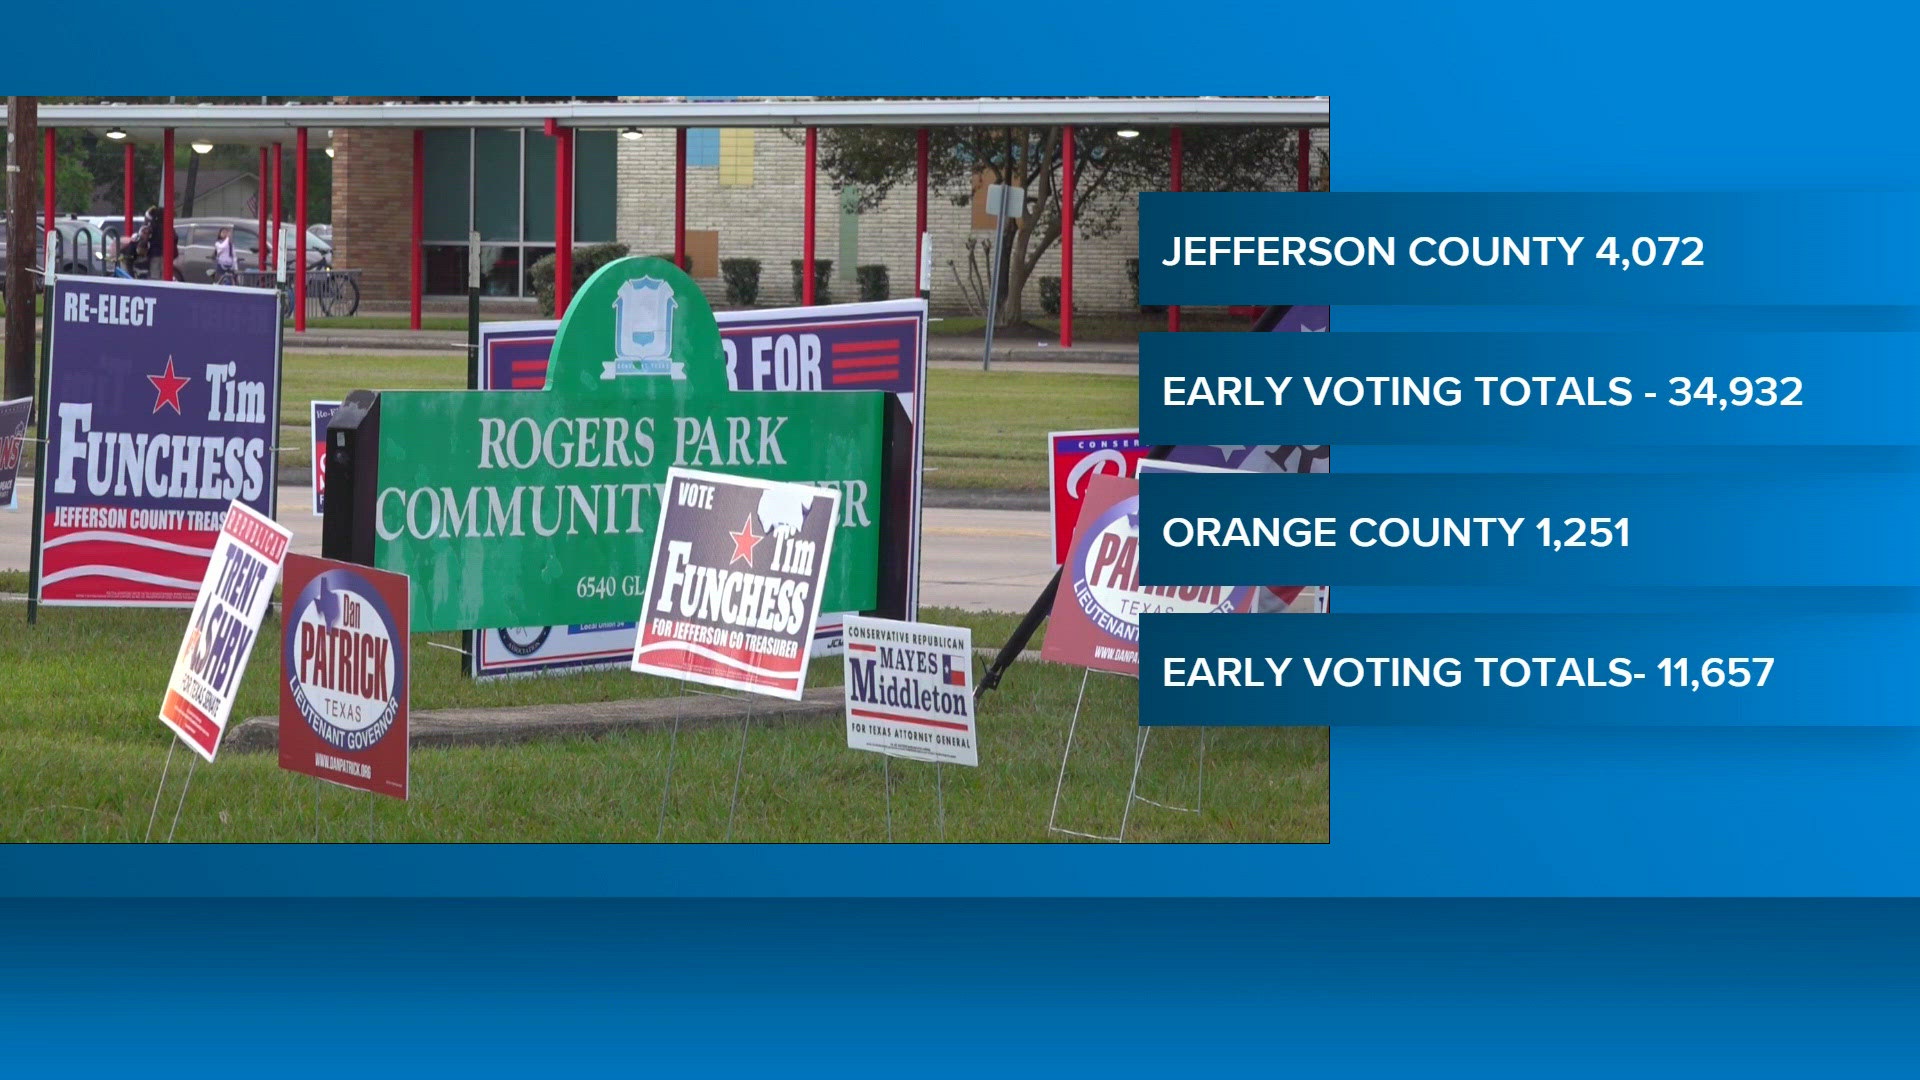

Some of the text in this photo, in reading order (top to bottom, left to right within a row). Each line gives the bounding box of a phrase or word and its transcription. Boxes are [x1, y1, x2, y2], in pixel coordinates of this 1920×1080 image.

[64, 292, 157, 326] RE-ELECT
[752, 333, 822, 391] FOR
[206, 361, 265, 424] Tim
[54, 403, 264, 500] FUNCHESS
[478, 416, 788, 470] ROGERS PARK
[1079, 439, 1139, 449] CONSER
[678, 482, 715, 510] VOTE
[54, 506, 228, 532] JEFFERSON COUNTY TREAS
[227, 509, 286, 560] REPUBLICAN
[770, 524, 815, 576] Tim
[215, 542, 267, 617] TRENT
[577, 575, 644, 598] 6540 GL
[656, 540, 809, 635] FUNCHESS
[343, 594, 360, 628] Dan
[651, 618, 799, 659] FOR JEFFERSON CO TREASURER
[848, 626, 964, 650] CONSERVATIVE REPUBLICAN
[301, 621, 388, 702] PATRICK
[880, 647, 938, 675] MAYES
[849, 657, 967, 716] Middleton
[290, 675, 398, 749] LIEUTENANT GOVERNOR
[325, 698, 361, 722] TEXAS
[852, 723, 970, 749] FOR TEXAS ATTORNEY GENERAL
[315, 752, 371, 779] WWW.DANPATRICK.ORG
